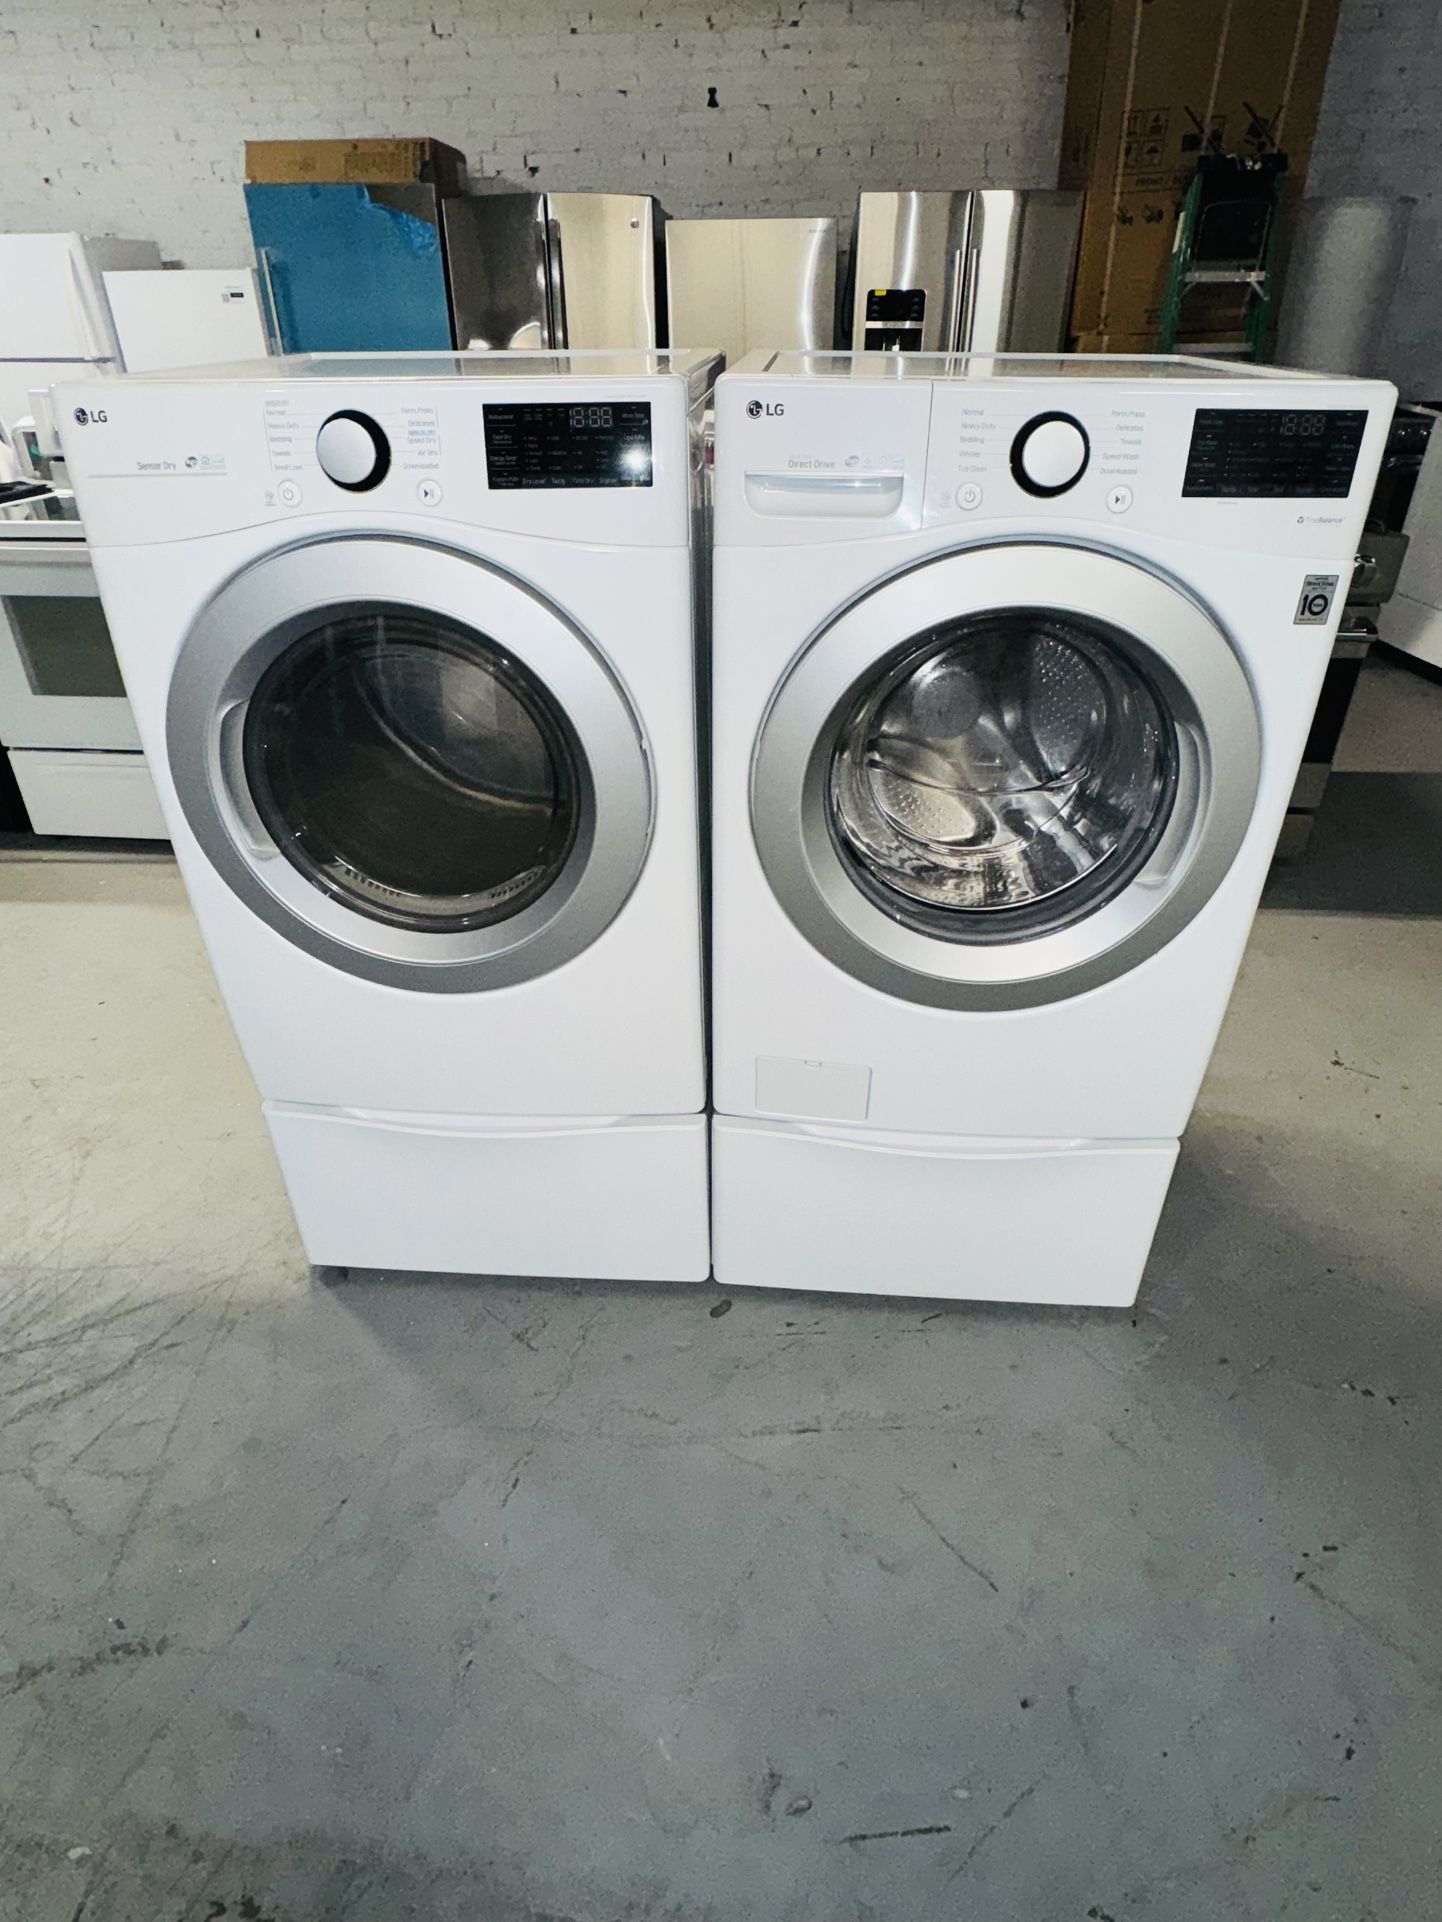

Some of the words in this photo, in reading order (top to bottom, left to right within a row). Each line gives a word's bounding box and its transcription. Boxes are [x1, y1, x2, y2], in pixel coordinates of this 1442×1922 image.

[766, 403, 785, 416] LG
[90, 410, 108, 423] LG
[981, 422, 997, 430] Duty
[137, 461, 162, 471] Sensor
[163, 461, 177, 472] Dry
[788, 459, 813, 469] Direct
[814, 459, 835, 469] Drive
[1300, 594, 1329, 616] 10
